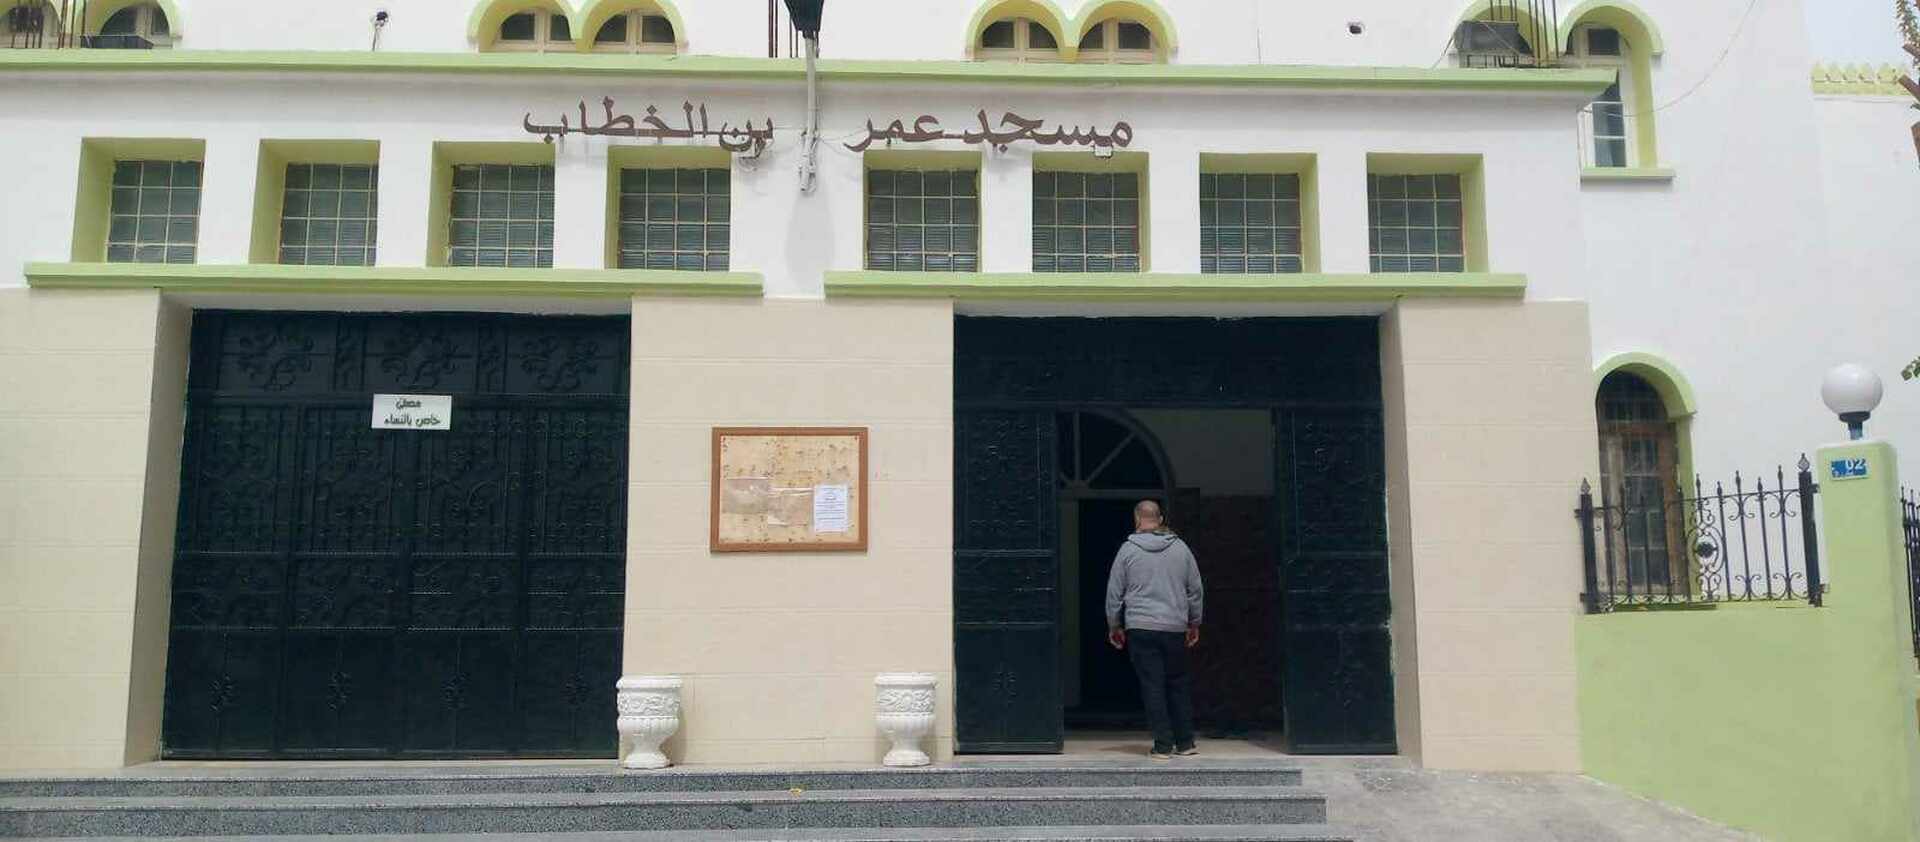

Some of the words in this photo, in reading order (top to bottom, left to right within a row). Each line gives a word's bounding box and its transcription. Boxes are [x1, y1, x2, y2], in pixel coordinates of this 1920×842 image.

[524, 96, 708, 144] الخطاب
[718, 117, 774, 152] بن
[843, 115, 944, 152] عمر
[963, 109, 1132, 152] مسجد
[415, 414, 441, 428] خاص
[1845, 458, 1867, 470] 02
